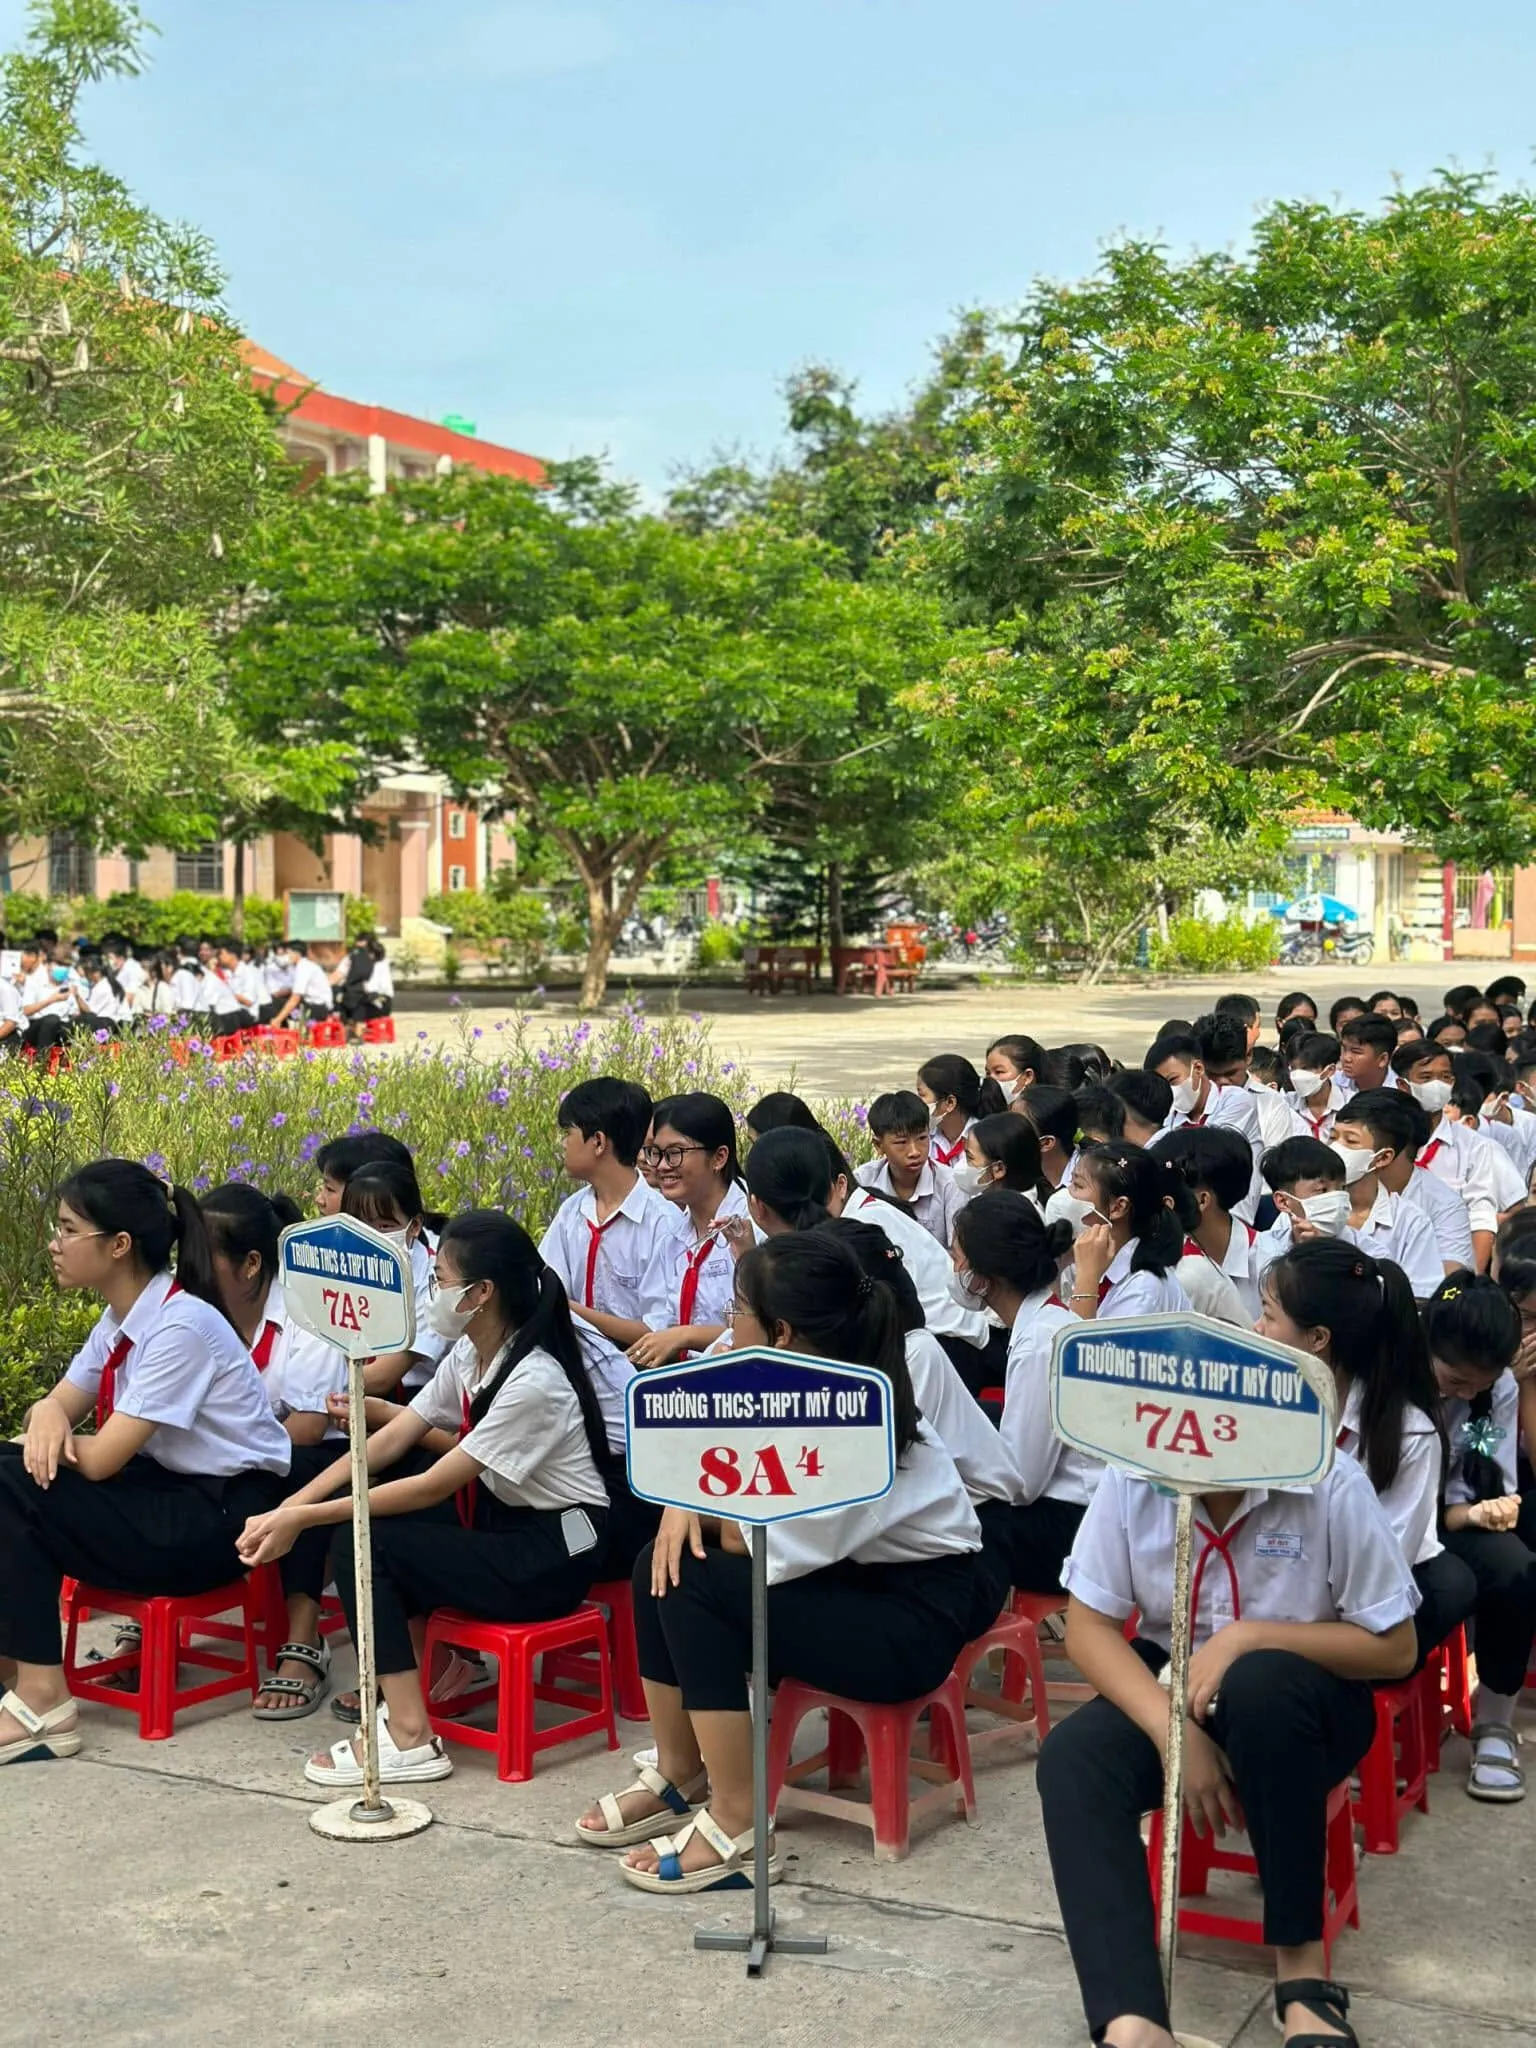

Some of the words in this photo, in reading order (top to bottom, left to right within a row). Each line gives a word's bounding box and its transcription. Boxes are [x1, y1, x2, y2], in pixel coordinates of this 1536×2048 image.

[319, 1247, 339, 1274] THCS
[340, 1252, 348, 1276] &
[347, 1252, 366, 1279] THPT
[367, 1254, 379, 1281] MỸ
[379, 1256, 394, 1287] QUÝ
[1076, 1340, 1136, 1380] TRƯỜNG
[1138, 1351, 1178, 1386] THCS
[1181, 1359, 1196, 1389] &
[1199, 1360, 1239, 1395] THPT
[1242, 1363, 1269, 1400] MỸ
[1271, 1367, 1304, 1406] QUÝ
[643, 1387, 708, 1420] TRƯỜNG
[712, 1391, 801, 1419] THCS-THPT
[805, 1386, 831, 1418] MỸ
[835, 1385, 868, 1420] QUÝ
